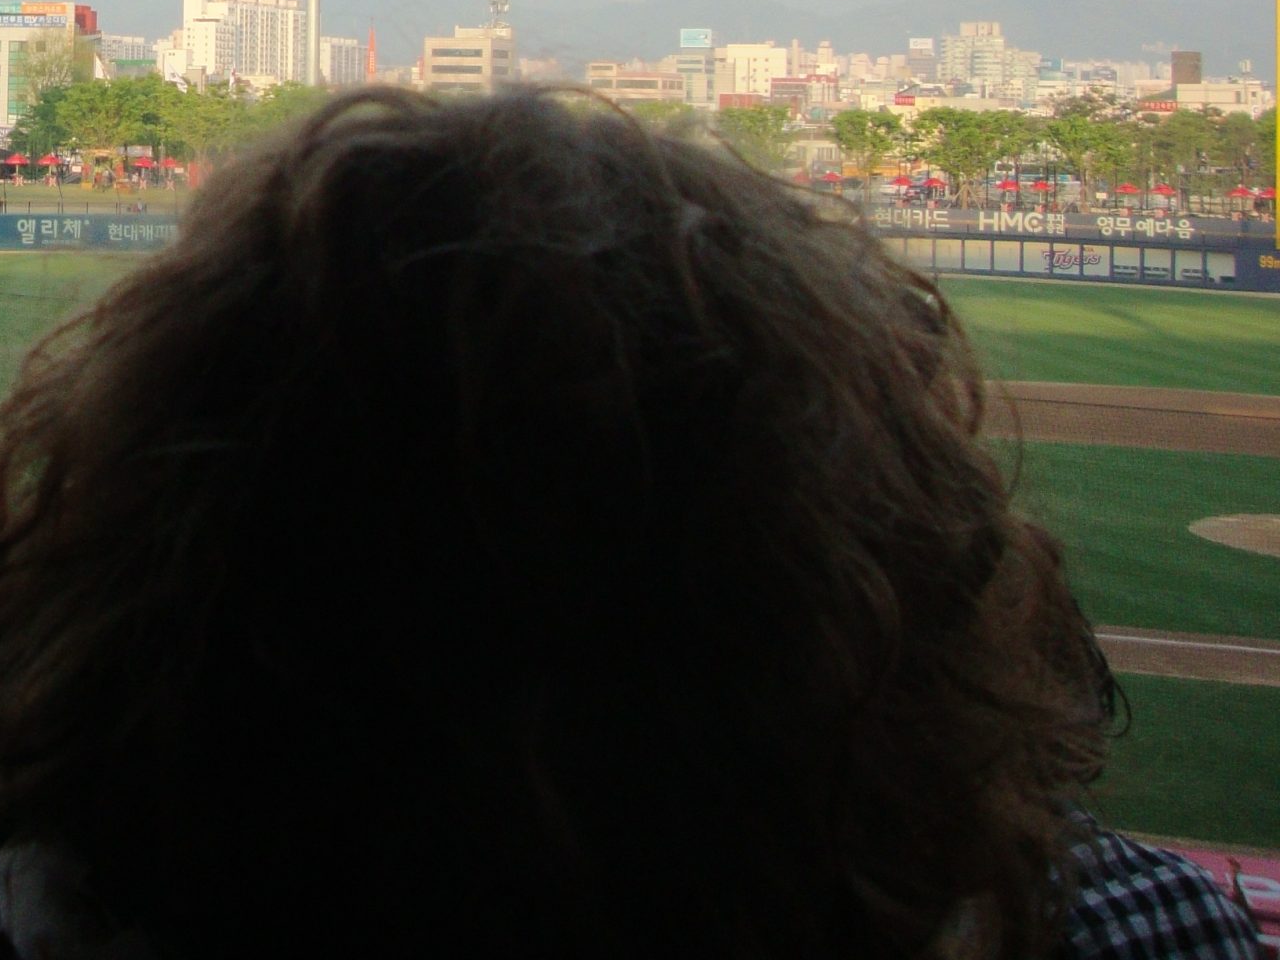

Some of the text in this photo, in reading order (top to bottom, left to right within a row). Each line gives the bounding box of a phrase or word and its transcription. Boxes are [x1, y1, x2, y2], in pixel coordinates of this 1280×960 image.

[875, 208, 950, 229] 현대카드
[979, 211, 1044, 233] HMC
[1097, 216, 1196, 239] 영무 예다음
[17, 219, 81, 244] 엘리체
